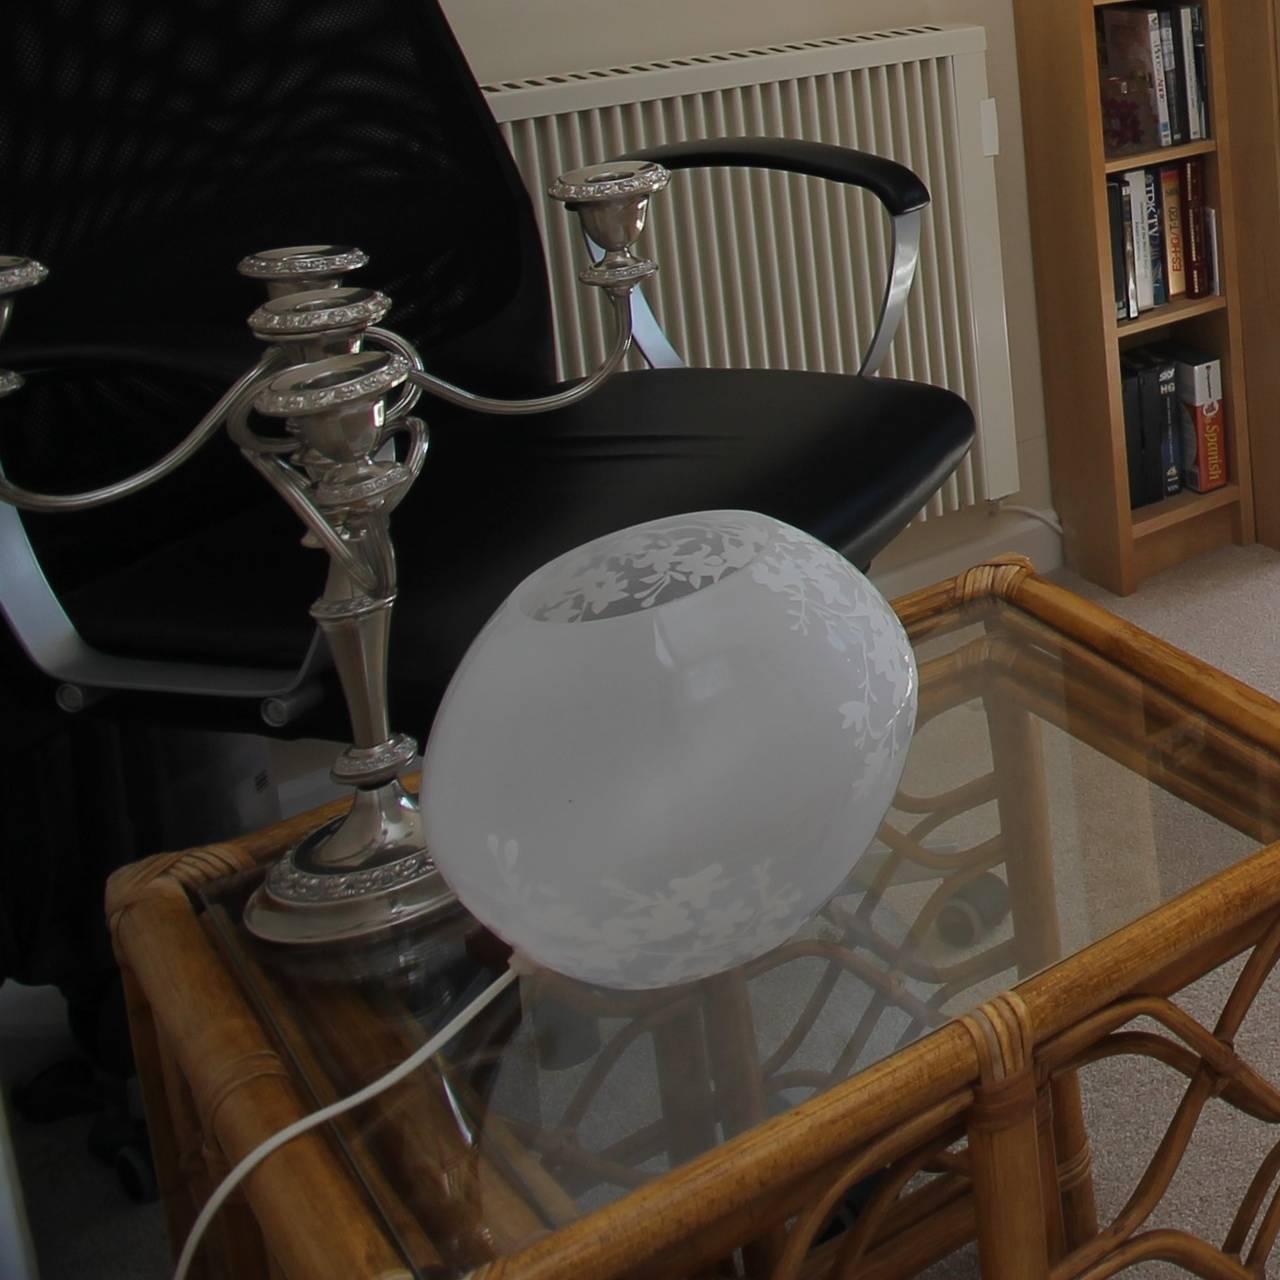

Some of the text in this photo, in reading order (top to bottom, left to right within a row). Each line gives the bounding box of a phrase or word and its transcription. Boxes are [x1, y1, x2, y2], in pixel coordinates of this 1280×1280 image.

[1145, 183, 1159, 236] TDK TV
[1204, 424, 1222, 480] Spanish
